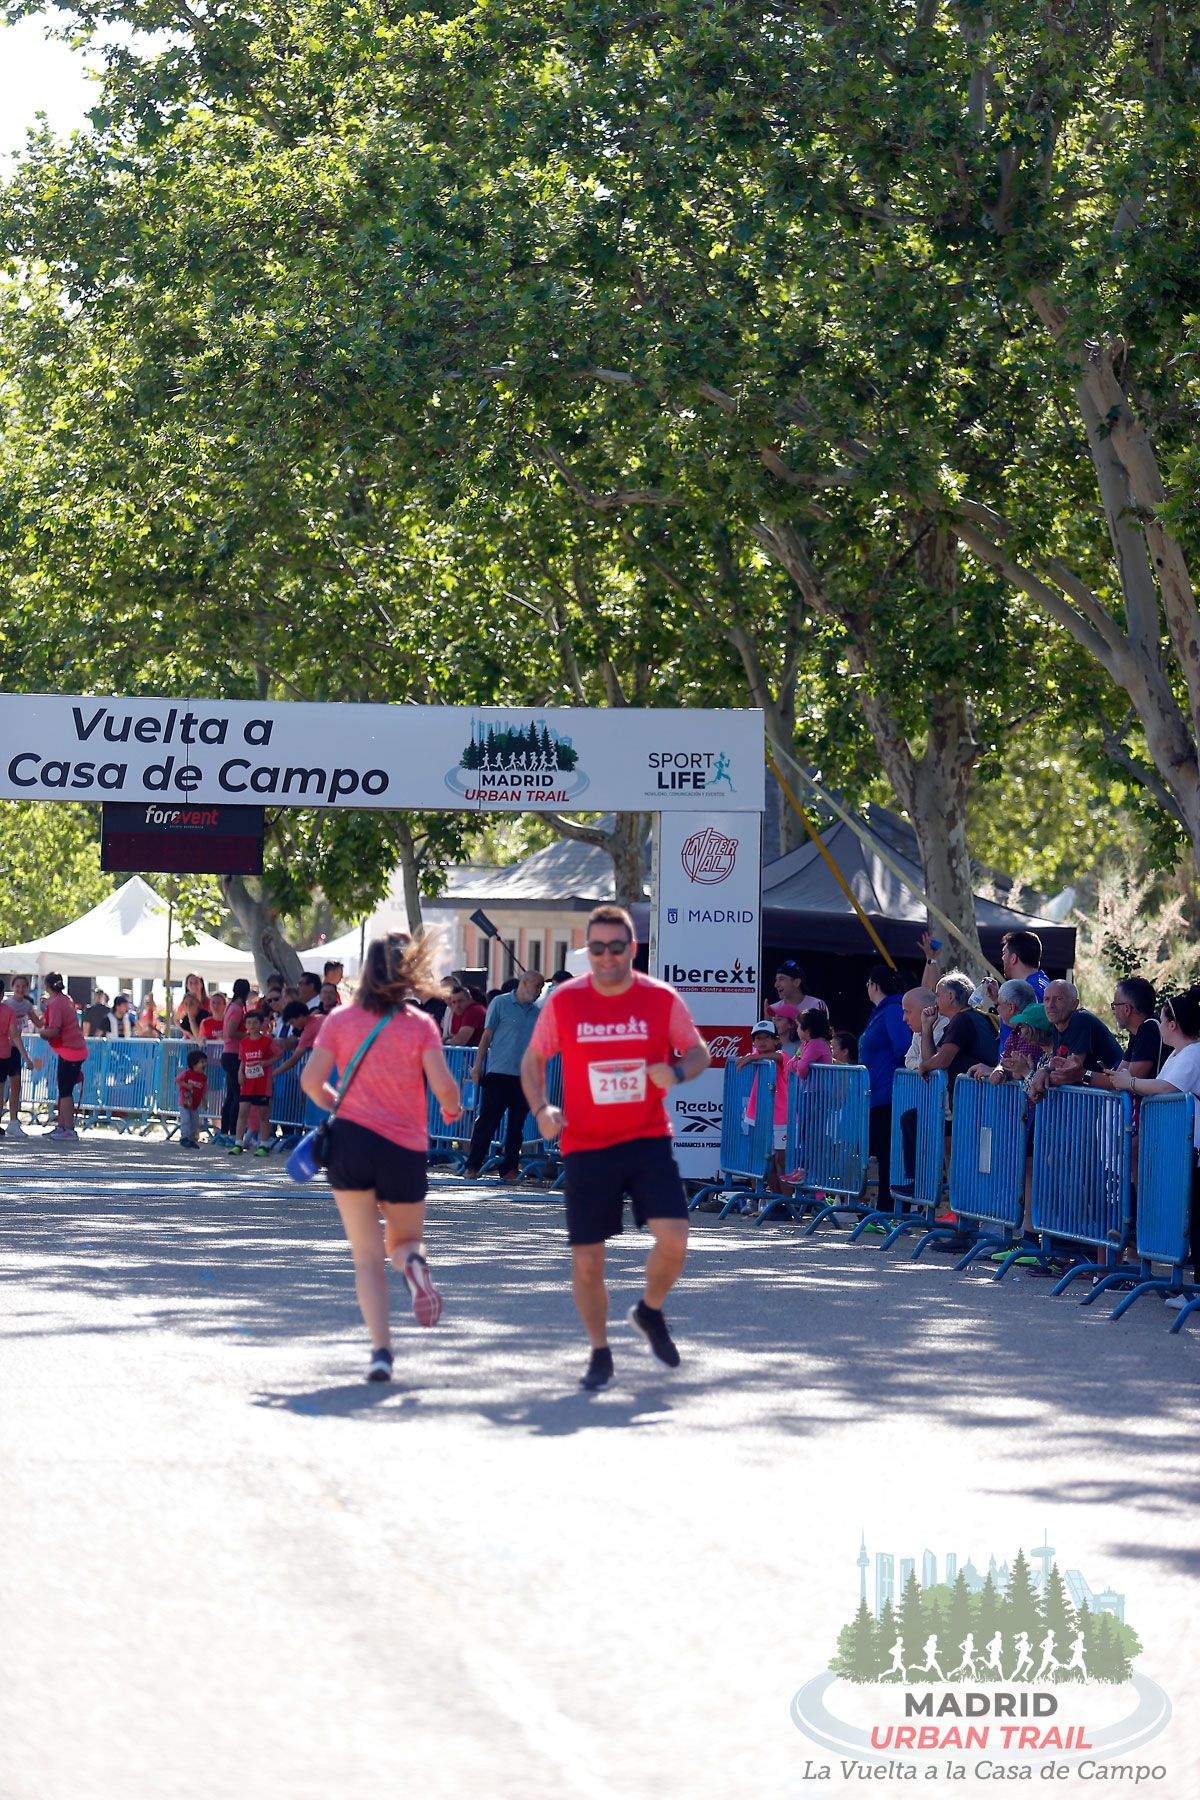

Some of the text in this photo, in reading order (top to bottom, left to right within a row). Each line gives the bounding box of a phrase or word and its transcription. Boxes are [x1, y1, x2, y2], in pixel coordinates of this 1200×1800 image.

[72, 707, 274, 746] Vuelta a
[648, 752, 714, 768] SPORT
[8, 752, 390, 803] Casa de Campo
[481, 774, 554, 786] MADRID
[657, 771, 706, 789] LIFE
[465, 789, 570, 802] URBAN TRAIL
[688, 910, 754, 923] MADRID
[664, 963, 756, 984] Iberext
[577, 1018, 648, 1037] Iberext
[599, 1077, 638, 1092] 2162
